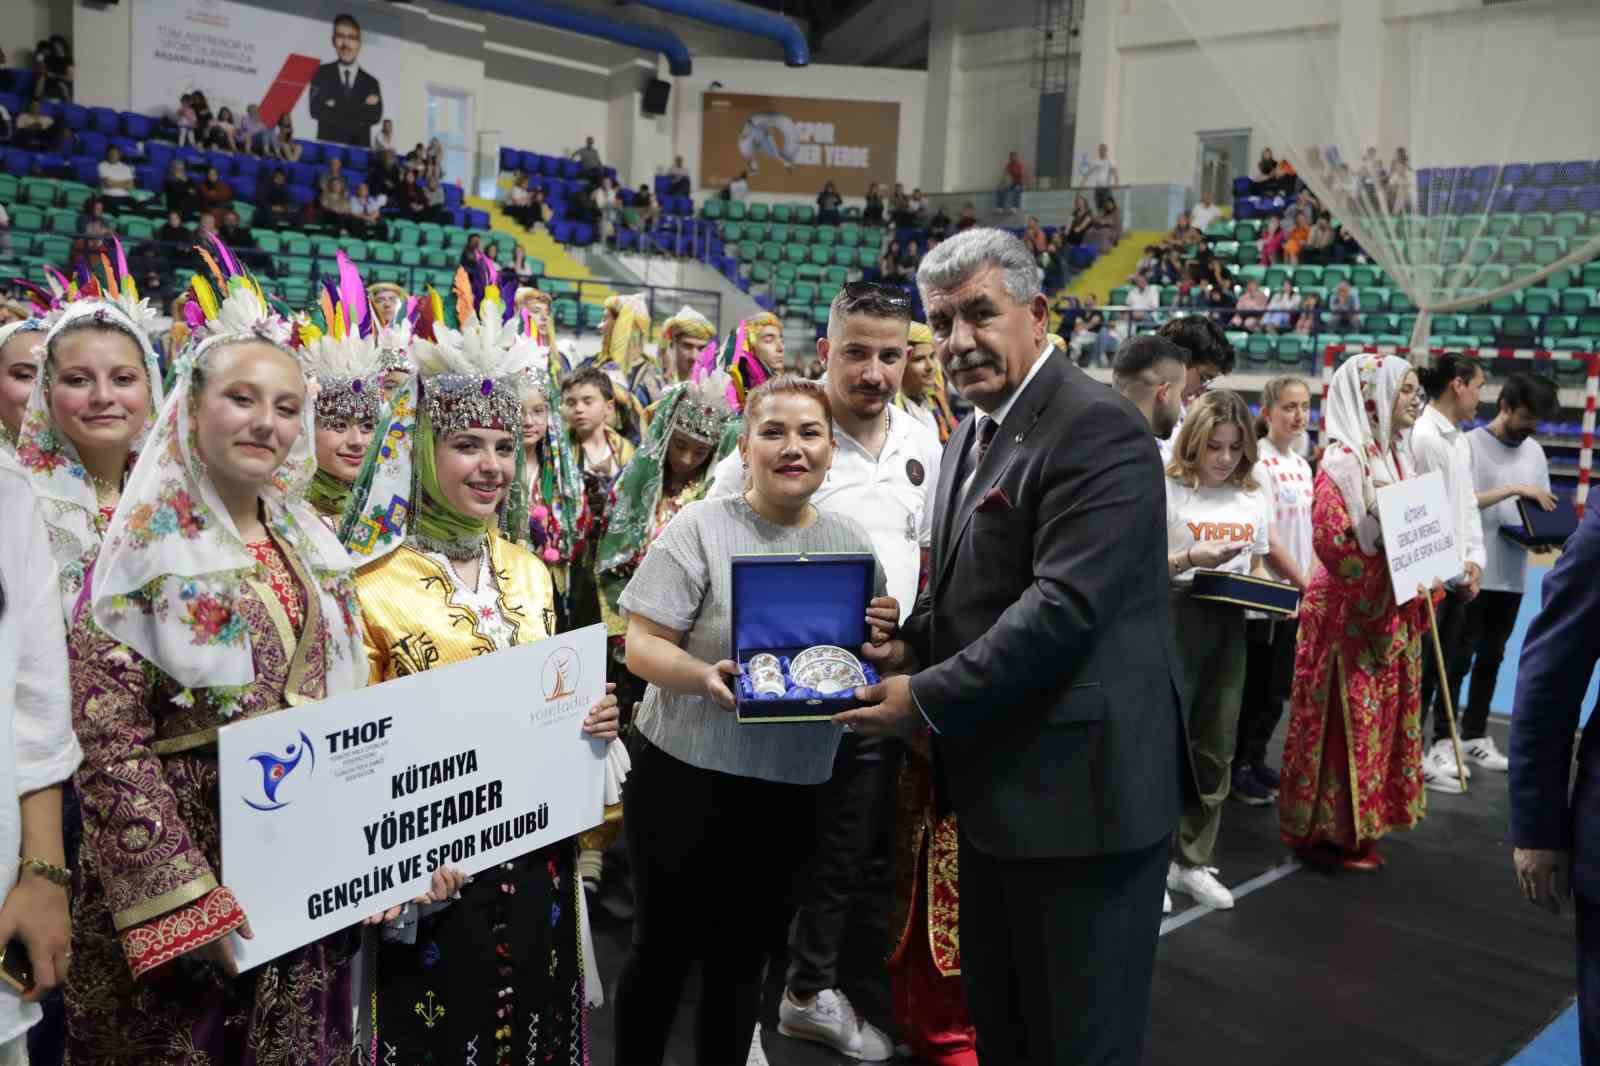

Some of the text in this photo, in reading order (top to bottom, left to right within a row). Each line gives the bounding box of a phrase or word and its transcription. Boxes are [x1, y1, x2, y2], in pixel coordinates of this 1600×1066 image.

[1186, 521, 1255, 543] YRFDR
[325, 716, 393, 753] THOF
[391, 749, 478, 799] KÜTAHYA
[363, 779, 503, 856] YÖREFADER
[307, 802, 549, 920] GENÇLİK VE SPOR KULUBÜ
